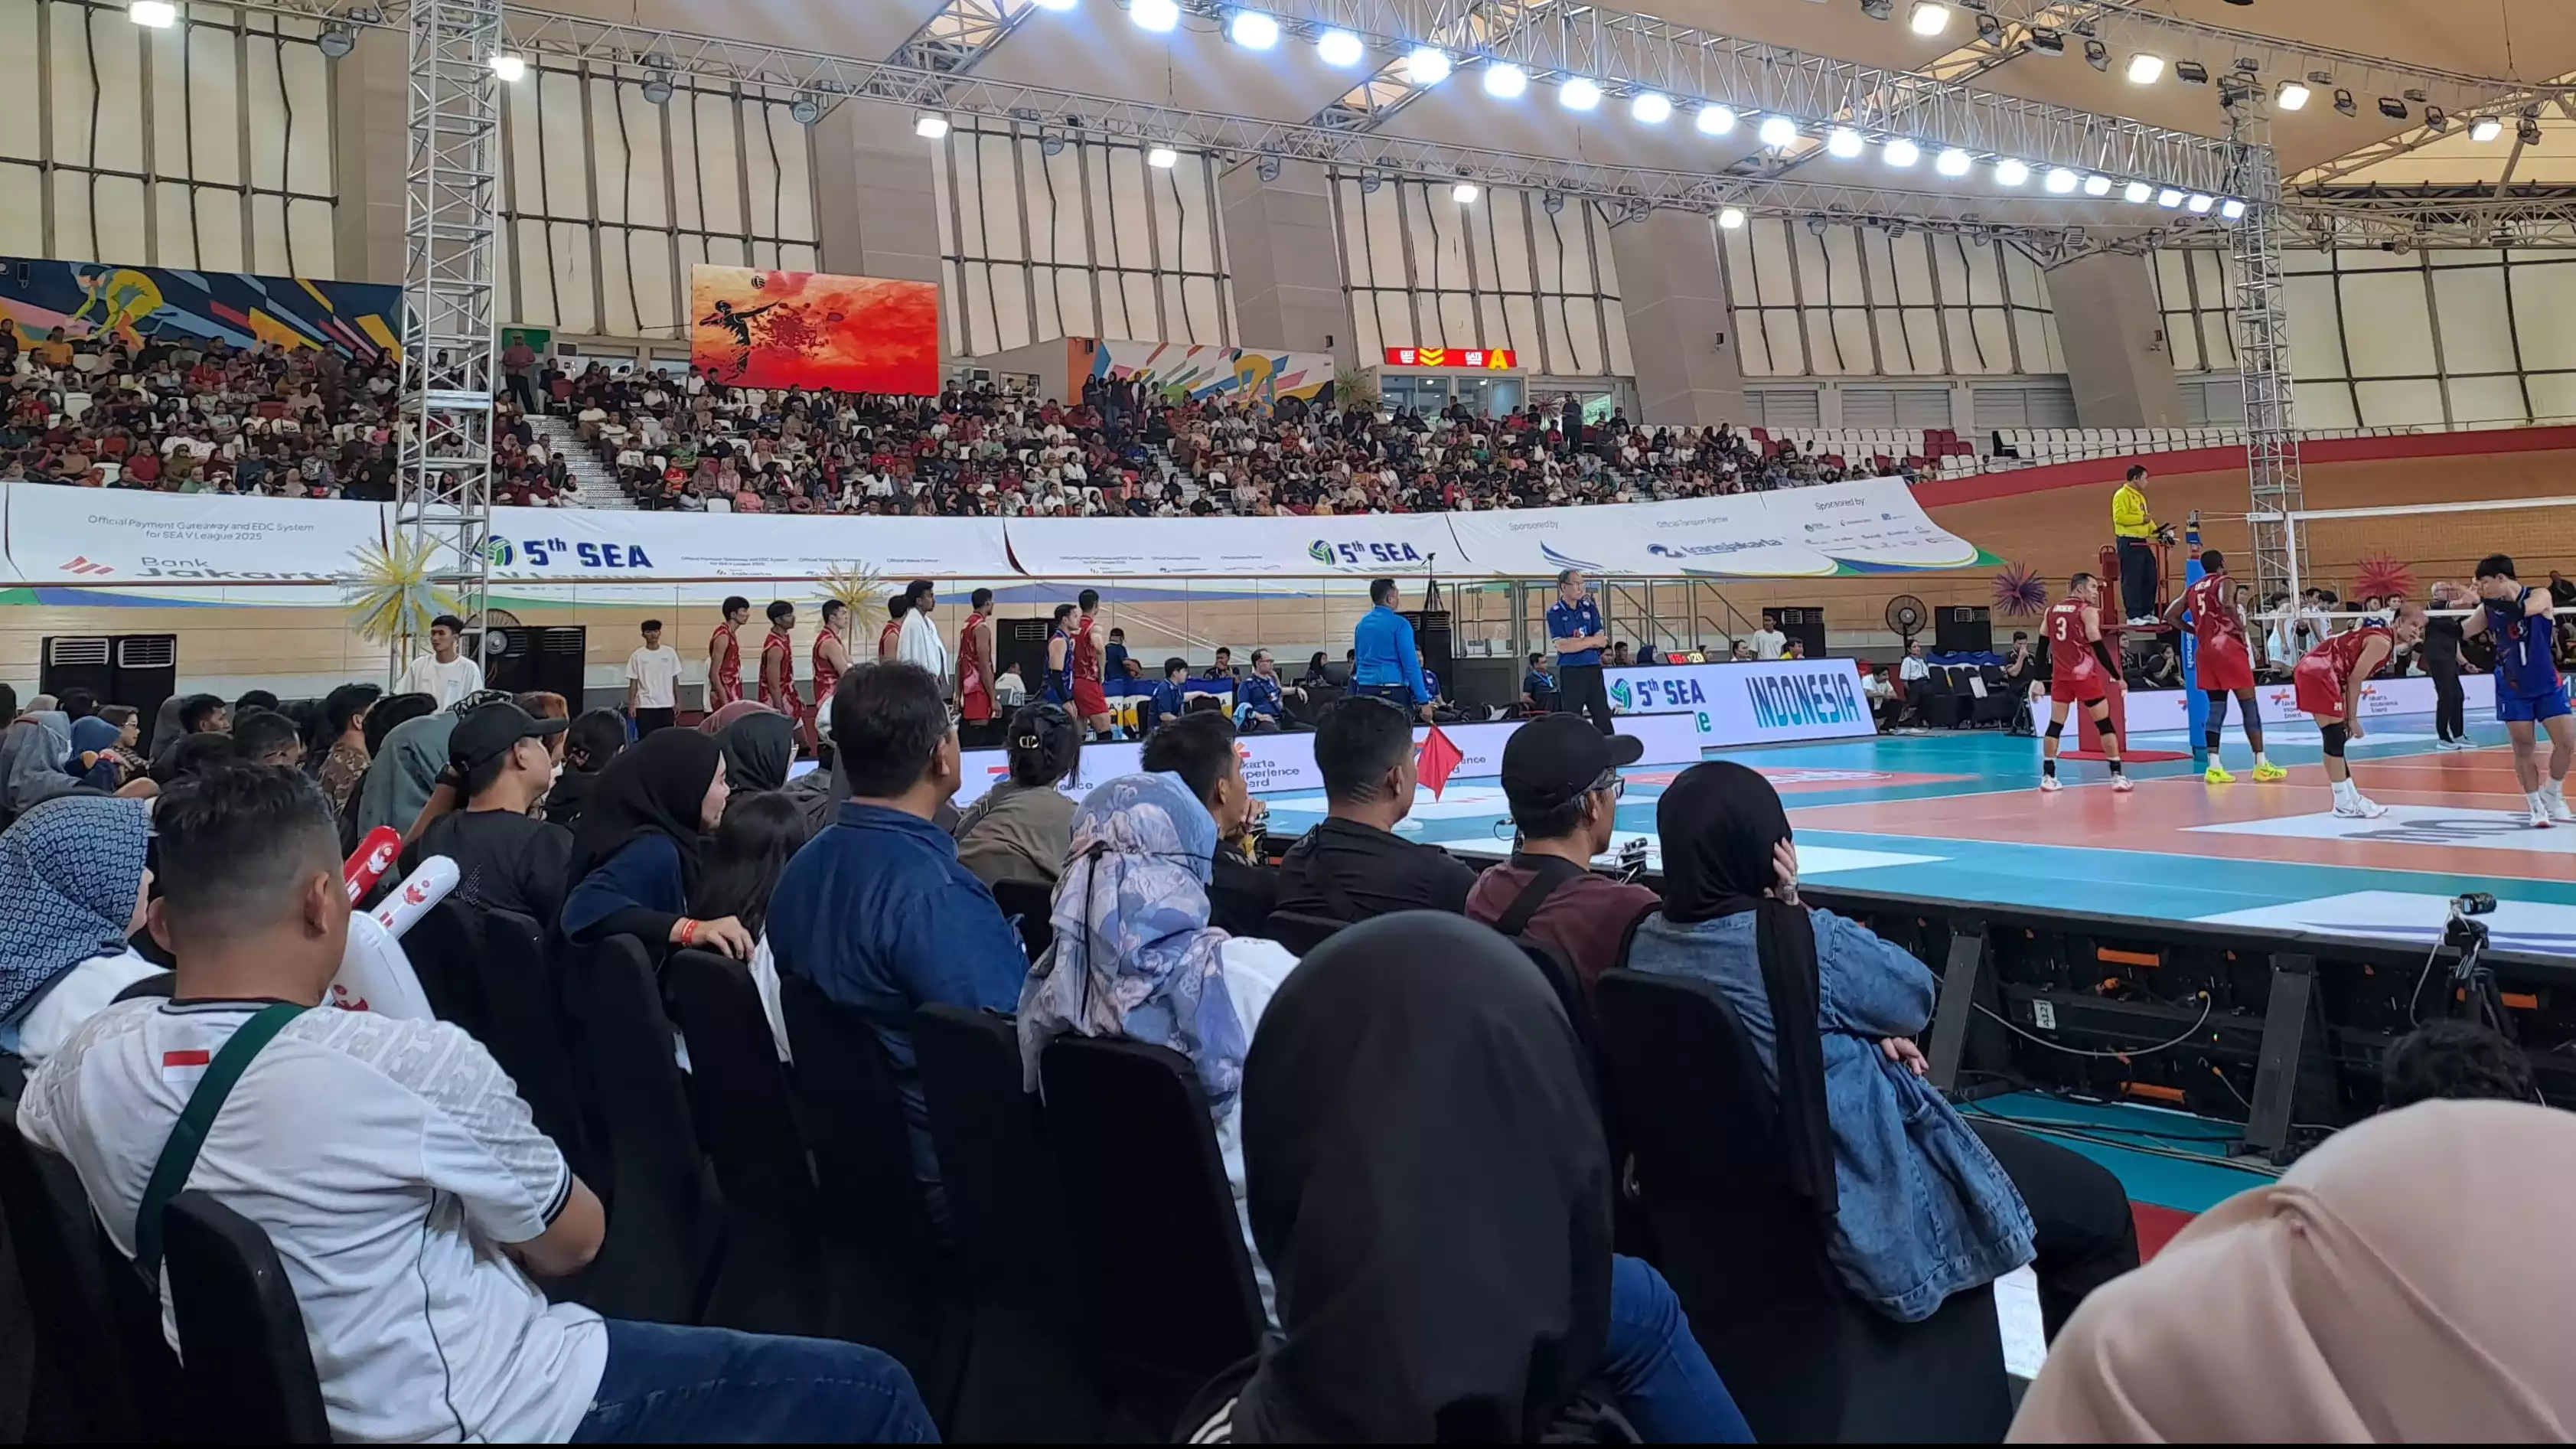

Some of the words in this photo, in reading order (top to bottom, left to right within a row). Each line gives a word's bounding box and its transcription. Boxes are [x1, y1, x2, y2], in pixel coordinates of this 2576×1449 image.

[1488, 348, 1509, 370] A
[88, 514, 128, 527] Official
[129, 517, 175, 530] Payment
[231, 522, 250, 531] and
[251, 521, 274, 531] EDC
[276, 522, 315, 533] System
[145, 530, 161, 539] for
[162, 530, 184, 540] SEA
[185, 531, 194, 540] V
[194, 531, 233, 542] League
[235, 532, 263, 540] 2025
[141, 556, 209, 568] Bank
[576, 541, 654, 568] SEA
[1369, 541, 1423, 562] SEA
[2196, 592, 2206, 616] 5
[2056, 615, 2067, 641] 3
[2519, 641, 2527, 666] 1
[1663, 678, 1707, 706] SEA
[1745, 672, 1862, 729] INDONESIA
